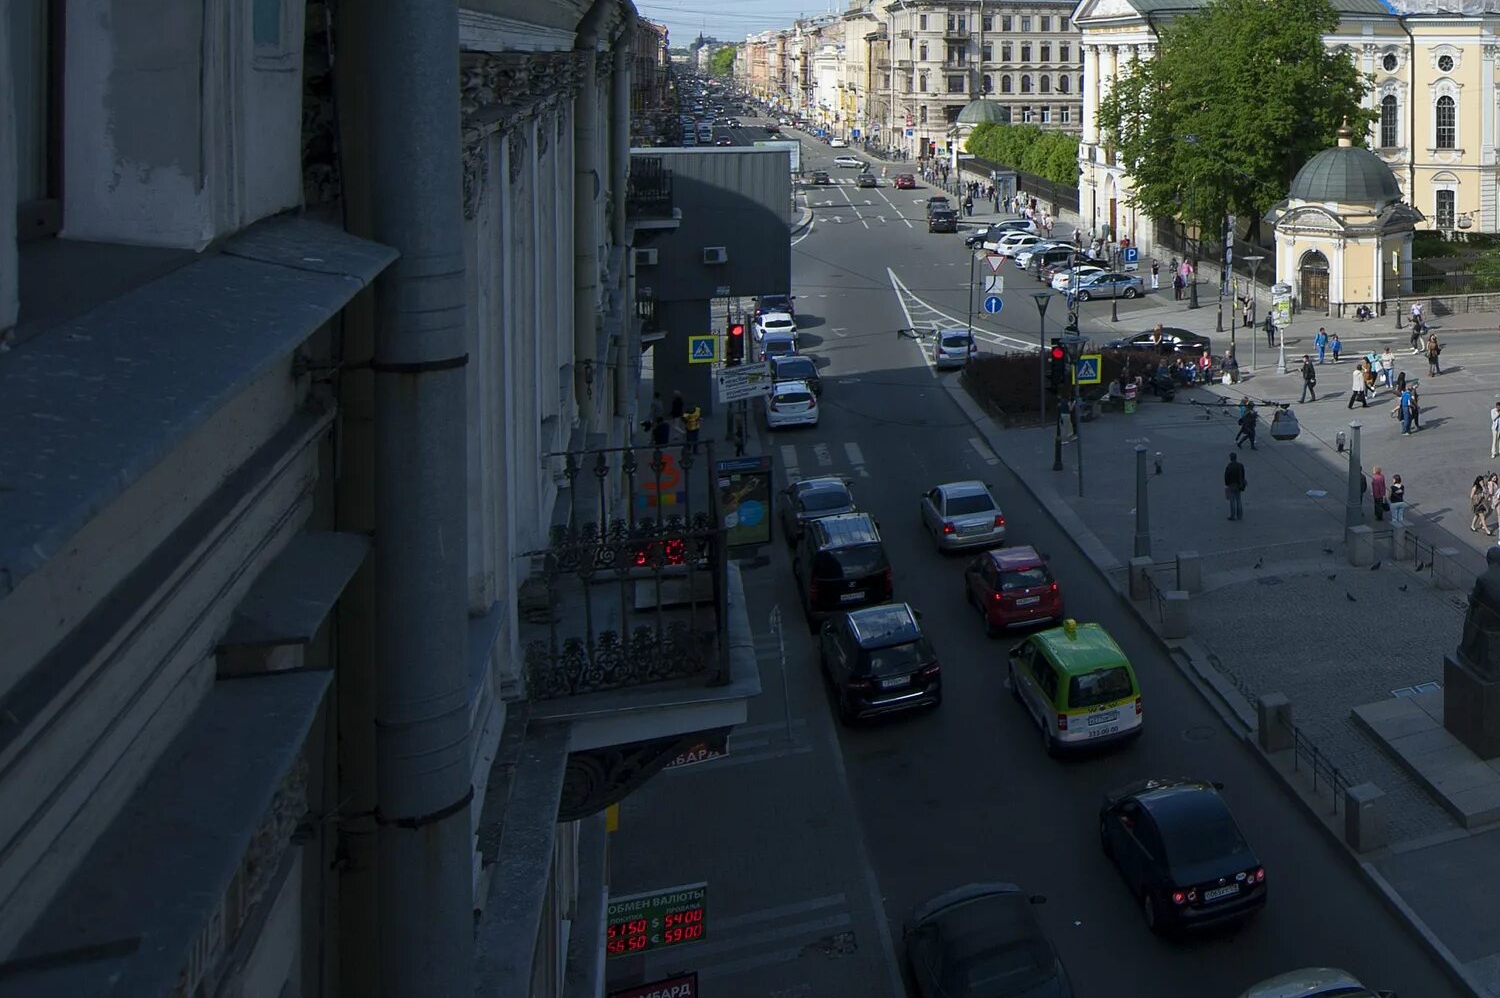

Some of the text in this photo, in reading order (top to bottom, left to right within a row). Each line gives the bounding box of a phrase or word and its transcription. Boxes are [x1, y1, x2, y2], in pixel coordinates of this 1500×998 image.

[1128, 249, 1136, 261] P
[608, 890, 704, 914] ОБМЕН ВАЛЮТЫ
[610, 913, 644, 924] ПОКУПКА
